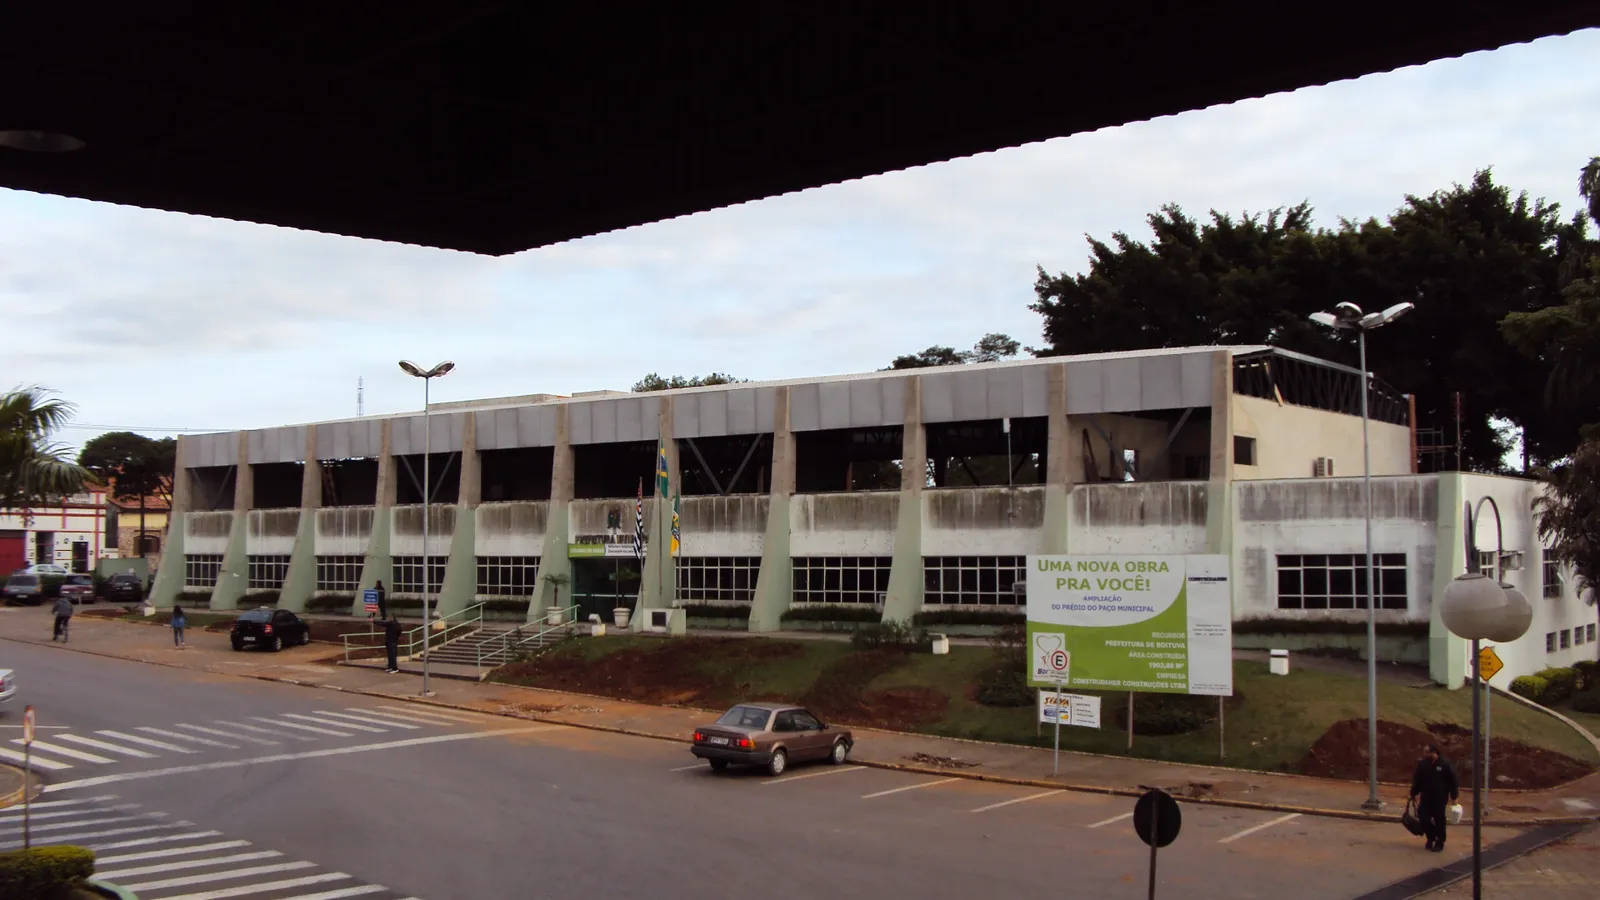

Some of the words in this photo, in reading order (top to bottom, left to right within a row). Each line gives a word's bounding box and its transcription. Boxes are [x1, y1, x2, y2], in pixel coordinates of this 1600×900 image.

[1038, 559, 1072, 572] UMA
[1077, 561, 1120, 573] NOVA
[1124, 561, 1170, 573] OBRA
[1056, 577, 1091, 590] PRA
[1097, 574, 1151, 591] VOCÊ!
[1083, 595, 1122, 603] AMPLIAÇÃO
[1062, 603, 1086, 611] PRÉDIO
[1098, 605, 1116, 613] PAÇO
[1117, 605, 1155, 613] MUNICIPAL
[1105, 640, 1145, 648] PREFEITURA
[1156, 641, 1186, 649] BOITUVA
[1055, 655, 1063, 667] E
